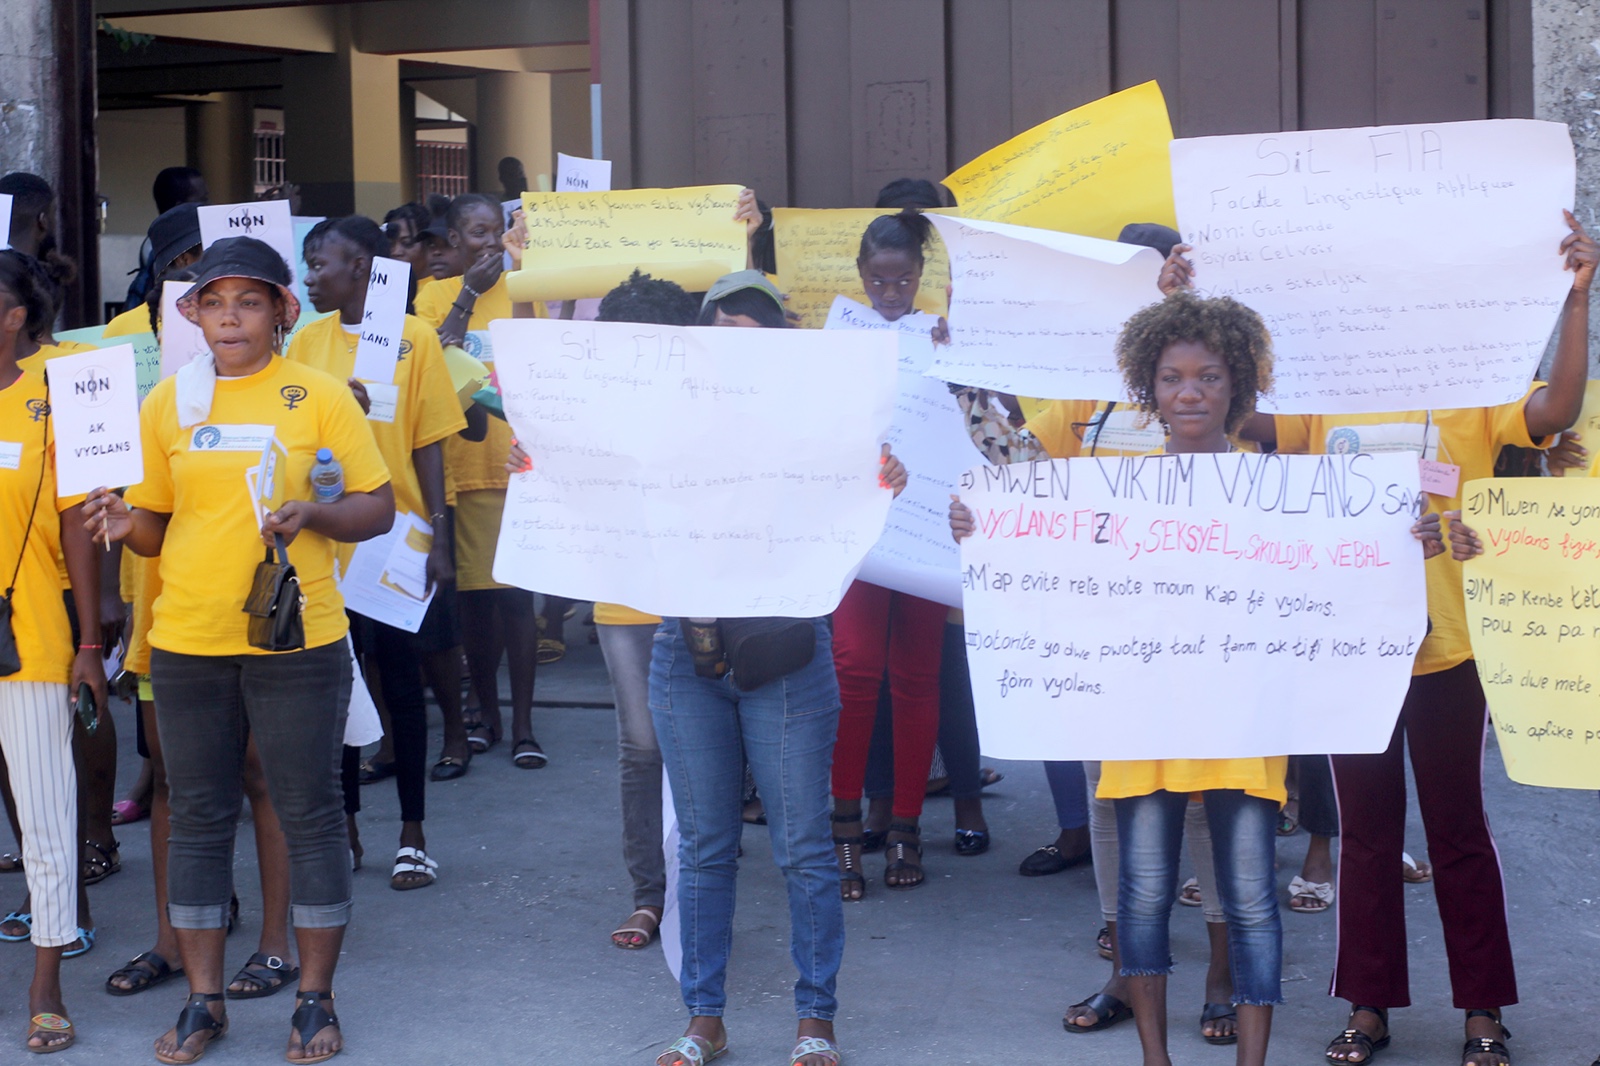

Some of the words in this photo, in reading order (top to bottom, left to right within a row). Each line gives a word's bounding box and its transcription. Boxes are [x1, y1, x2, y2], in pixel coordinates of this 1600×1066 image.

[566, 176, 588, 189] NON
[228, 214, 264, 228] NON
[75, 377, 110, 395] NON
[88, 422, 106, 434] AK
[74, 441, 131, 458] VYOLANS
[983, 458, 1070, 501] MWEN
[1212, 453, 1375, 518] VYOLANS
[976, 502, 1068, 540] VYOLANS
[1326, 537, 1391, 569] VÈBAL
[1021, 571, 1060, 592] evite
[1069, 575, 1100, 596] rete
[1153, 580, 1195, 597] moun
[1039, 642, 1060, 658] yo
[1064, 641, 1091, 660] dwe
[1099, 636, 1163, 663] pwoteje
[1219, 634, 1257, 663] fanm
[1520, 669, 1549, 689] dwe
[1554, 675, 1592, 694] mete
